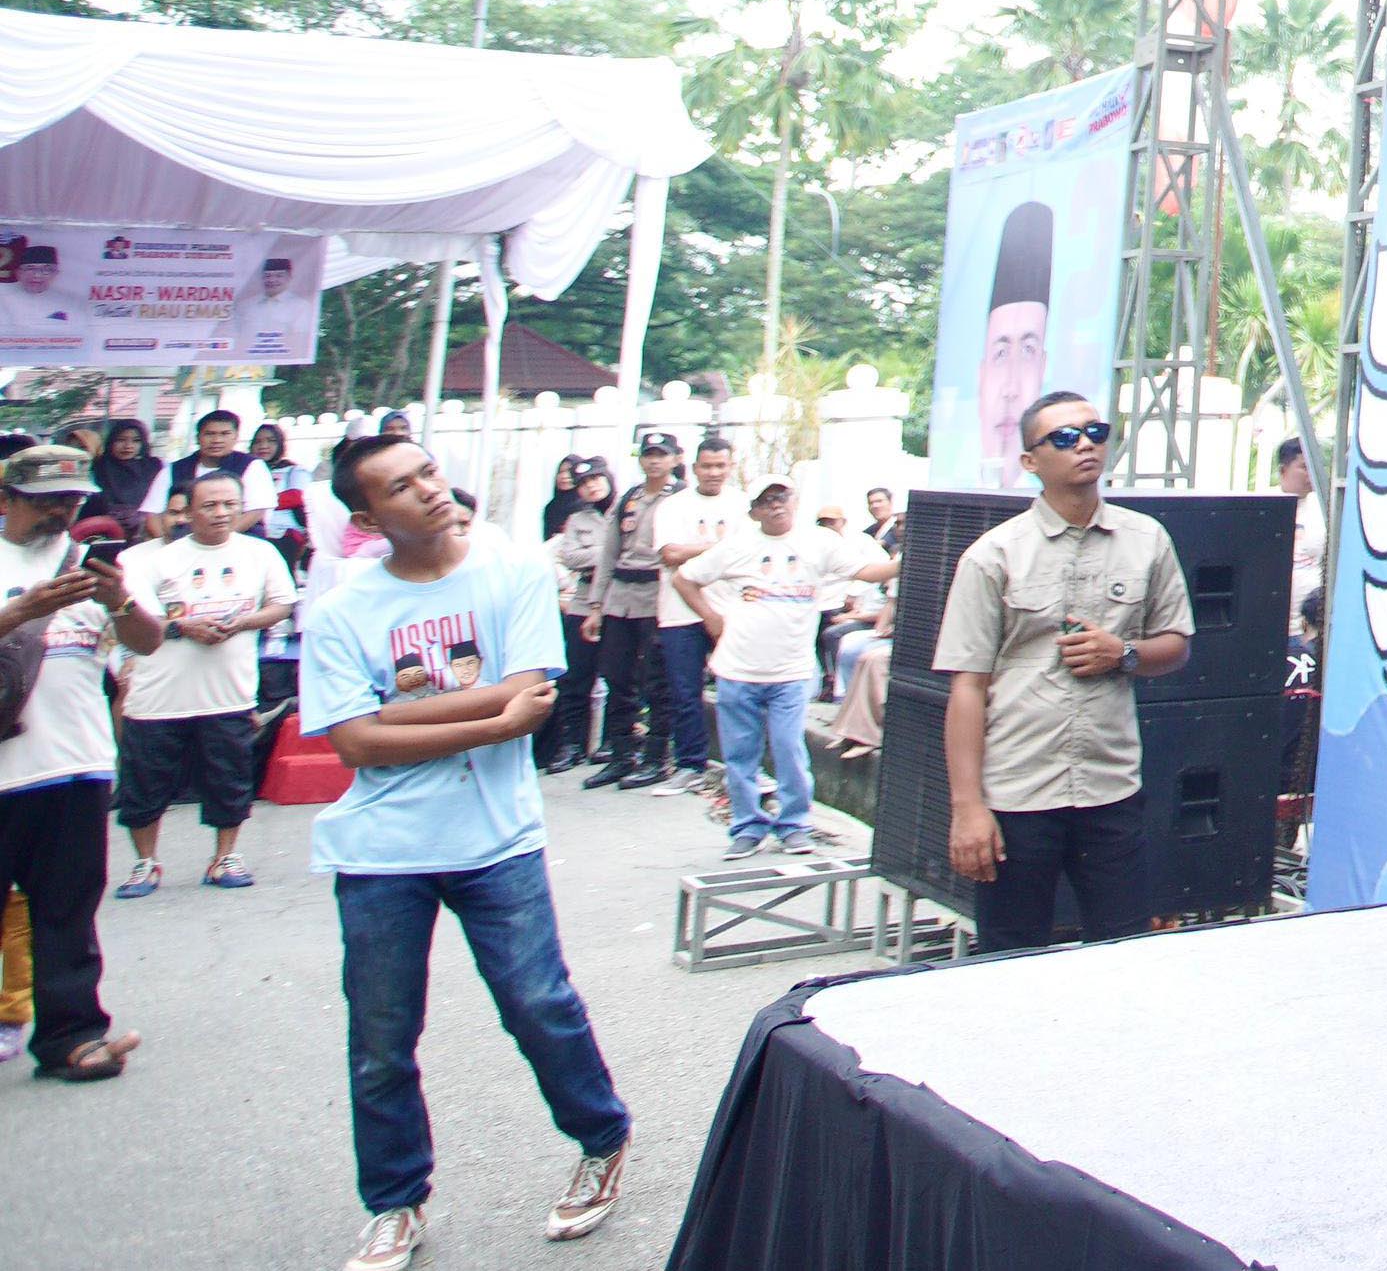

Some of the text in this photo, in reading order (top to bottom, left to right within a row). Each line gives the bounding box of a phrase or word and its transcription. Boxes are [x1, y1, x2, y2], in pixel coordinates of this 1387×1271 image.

[89, 285, 145, 301] NASIR
[157, 286, 234, 301] WARDAN
[139, 304, 180, 319] RIAU
[185, 304, 232, 319] EMAS
